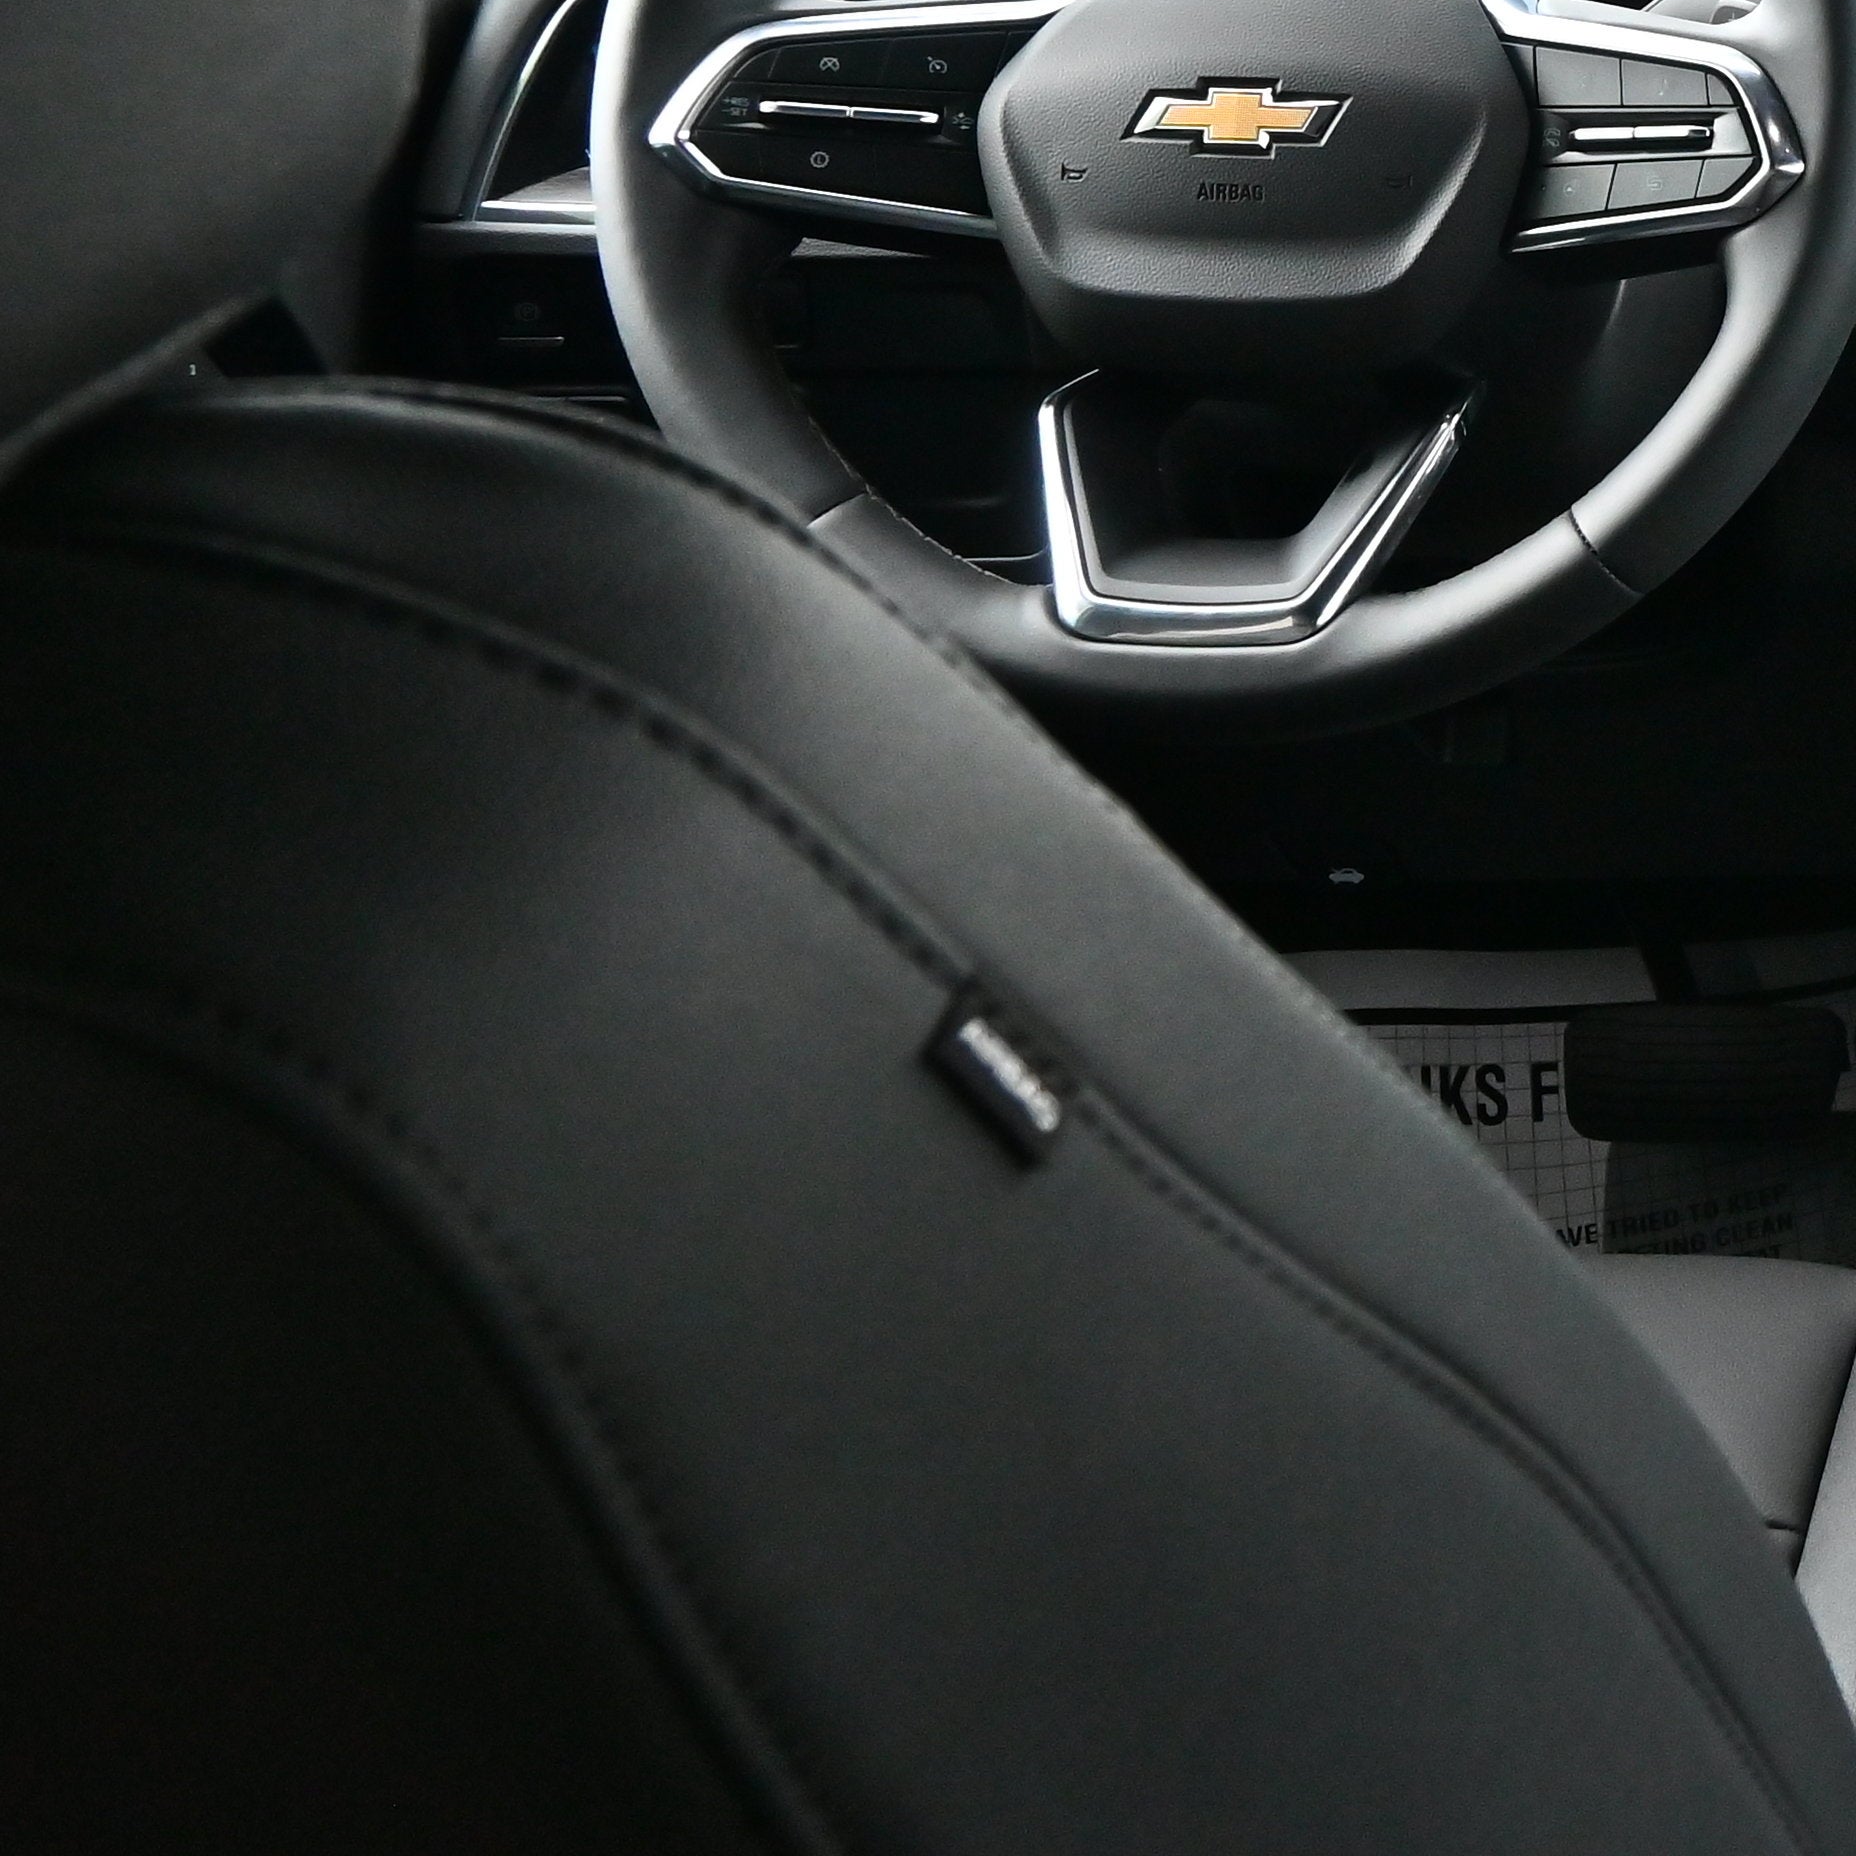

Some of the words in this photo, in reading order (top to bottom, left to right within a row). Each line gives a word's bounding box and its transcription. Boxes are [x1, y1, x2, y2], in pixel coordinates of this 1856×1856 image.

[1197, 181, 1265, 202] AIRBAG
[1557, 1223, 1597, 1247] VE
[1605, 1204, 1681, 1241] TRIED
[1687, 1197, 1720, 1222] TO
[1728, 1184, 1788, 1216] KEEP
[1716, 1212, 1795, 1248] CLEAN
